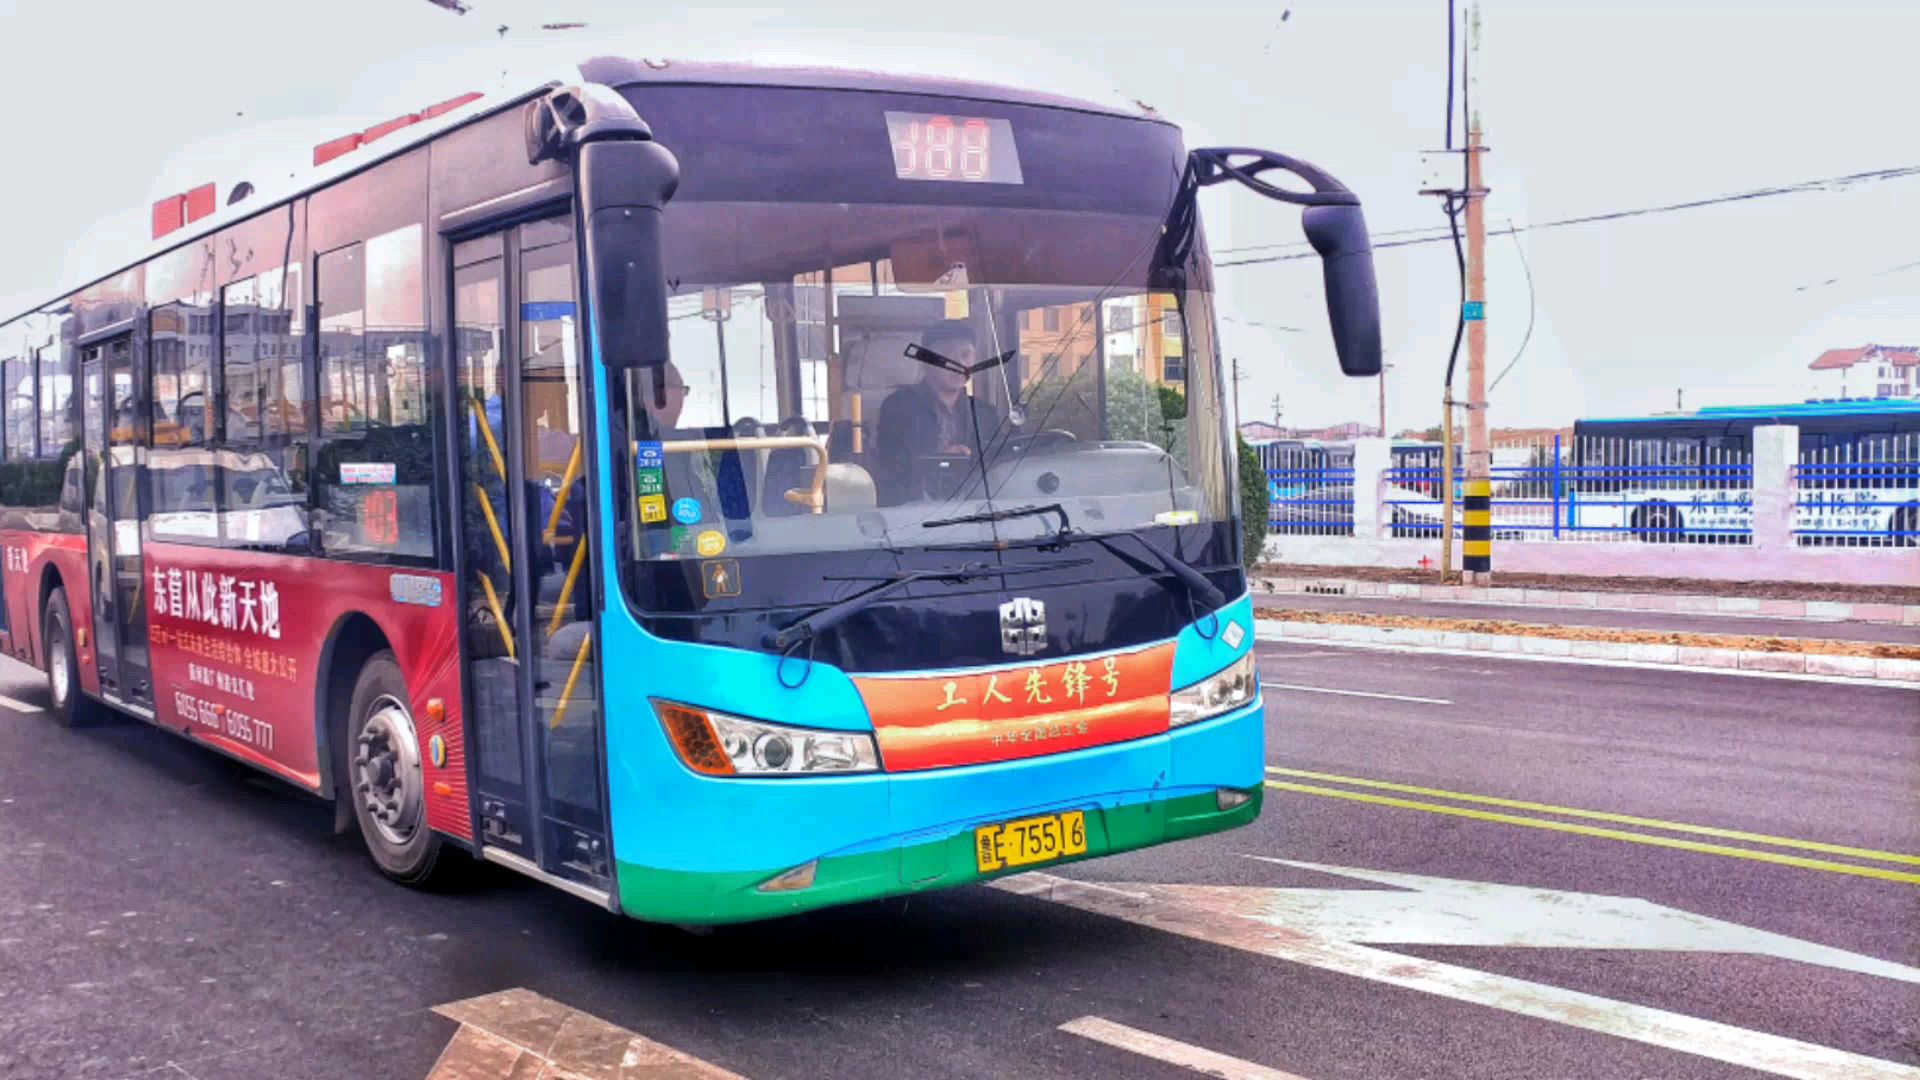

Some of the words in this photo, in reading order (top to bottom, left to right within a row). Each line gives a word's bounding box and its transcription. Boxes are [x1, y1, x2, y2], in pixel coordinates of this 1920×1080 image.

[152, 565, 281, 639] 东营从此新天地
[936, 656, 1120, 711] 工人先锋号
